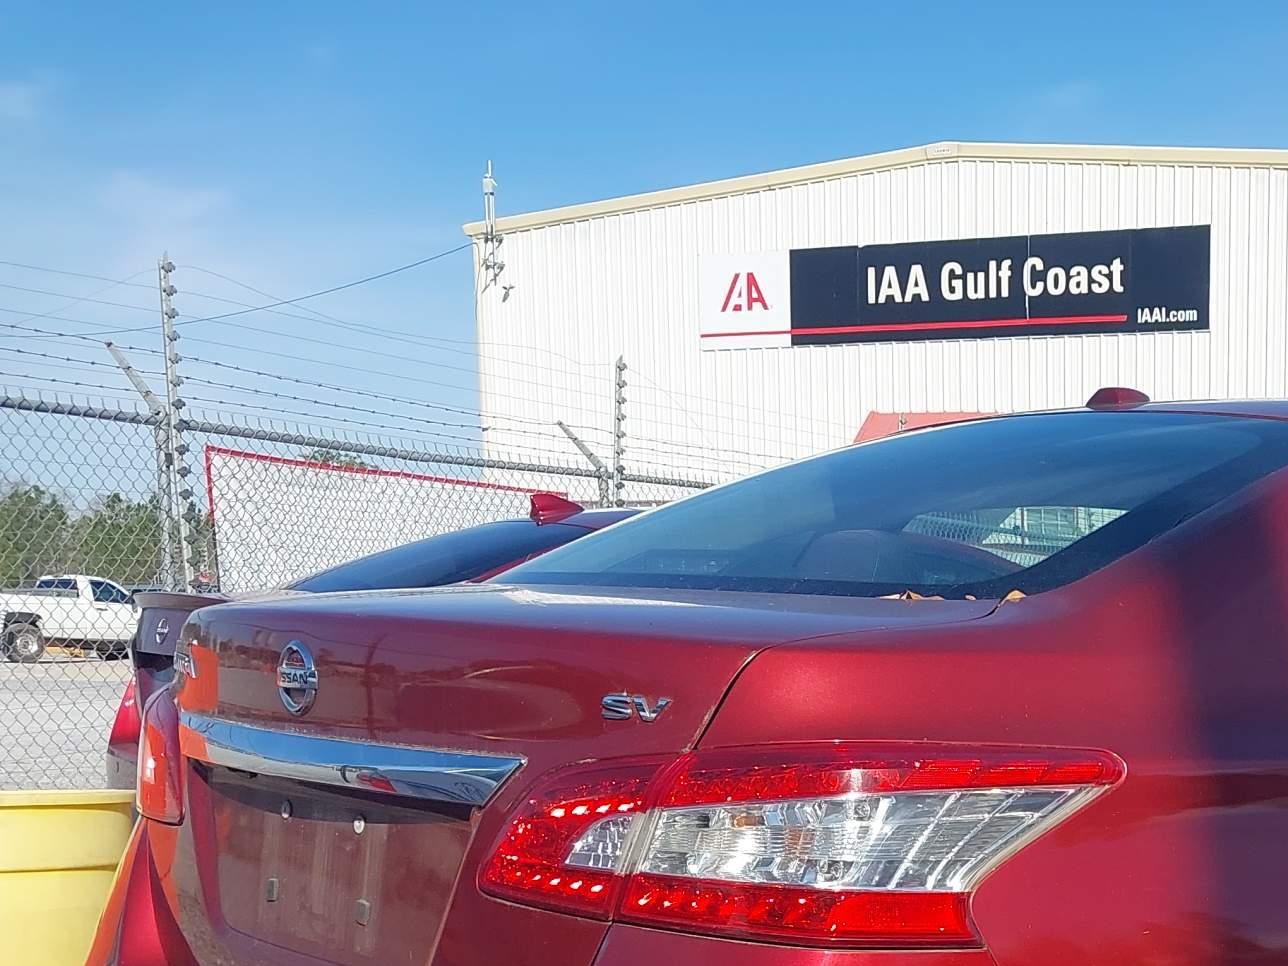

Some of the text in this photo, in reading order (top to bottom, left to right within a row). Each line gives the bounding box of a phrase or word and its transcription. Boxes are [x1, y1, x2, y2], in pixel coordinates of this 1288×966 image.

[867, 256, 1125, 304] IAA Gulf Coast
[1137, 306, 1198, 324] IAAI.com
[602, 693, 672, 722] SV
